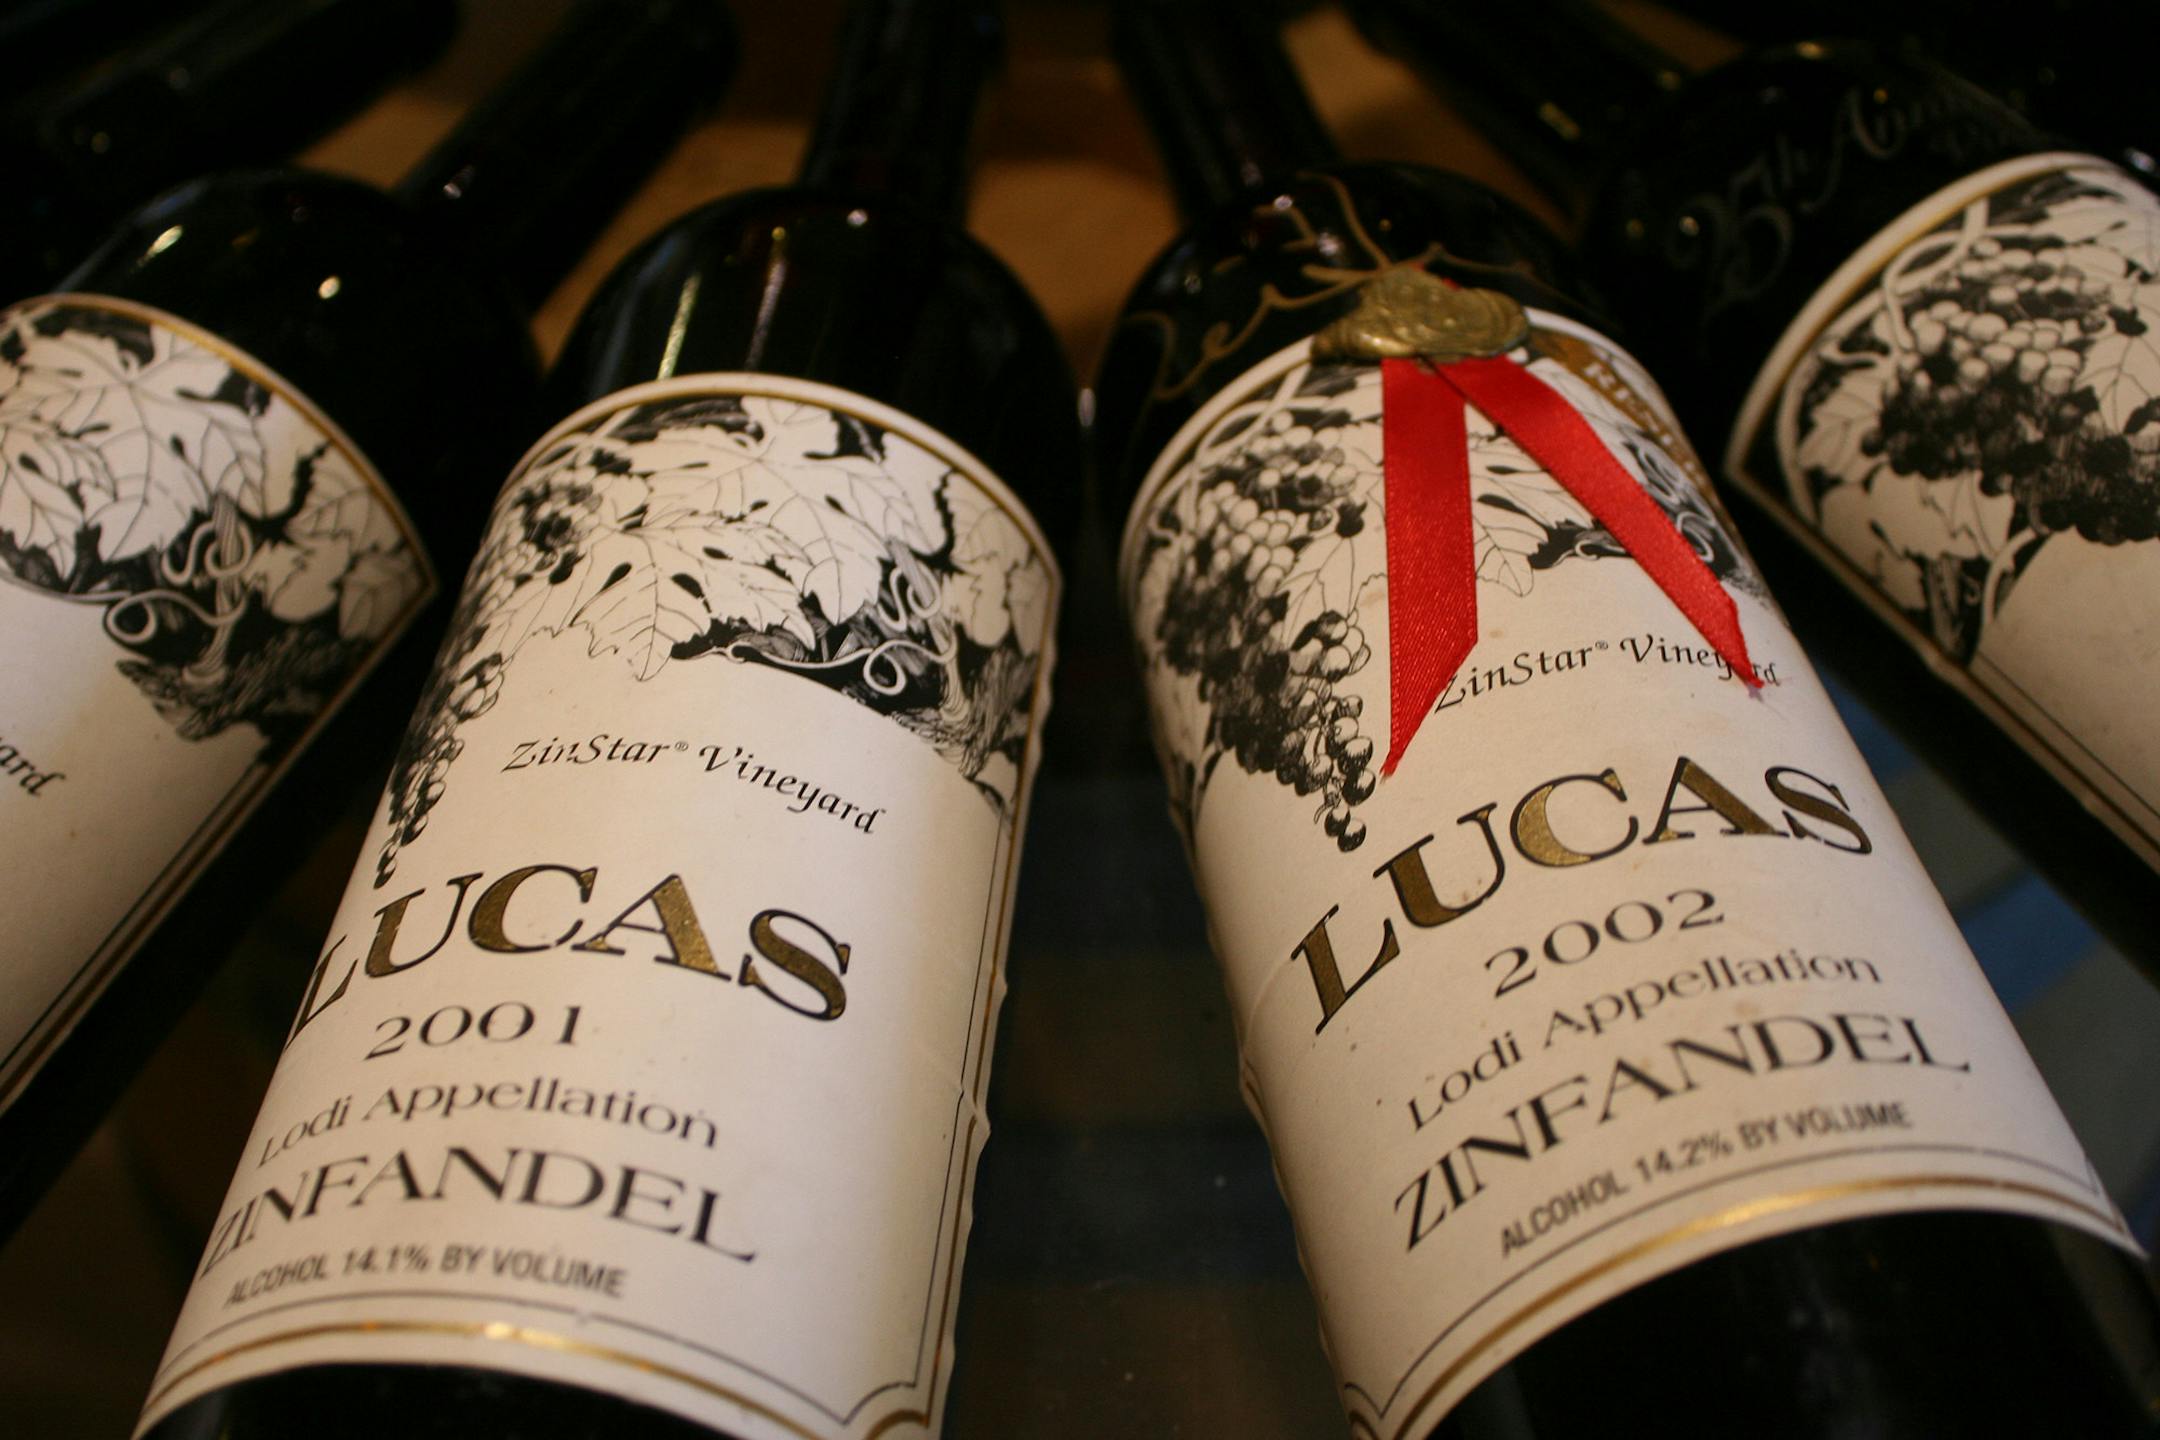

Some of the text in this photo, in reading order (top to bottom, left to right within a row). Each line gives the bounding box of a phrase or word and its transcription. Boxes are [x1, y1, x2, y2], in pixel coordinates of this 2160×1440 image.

[1619, 634, 1782, 688] Vineyrd
[698, 743, 887, 834] Vineyard
[1290, 756, 1873, 1035] LUCAS
[1484, 888, 1725, 998] 2002
[284, 863, 852, 1051] LUCAS
[364, 1001, 581, 1060] 2001
[1407, 948, 1882, 1131] Lodi Appellation
[257, 1077, 718, 1168] Lodi Appellation
[1394, 1012, 1971, 1253] ZINFANDEL
[1502, 1098, 1913, 1256] ALCOHOL 14.2% BY VOLUME
[199, 1146, 759, 1281] ZINFANDEL
[222, 1242, 627, 1309] ALCOHOL 14.1% BY VOLUME
